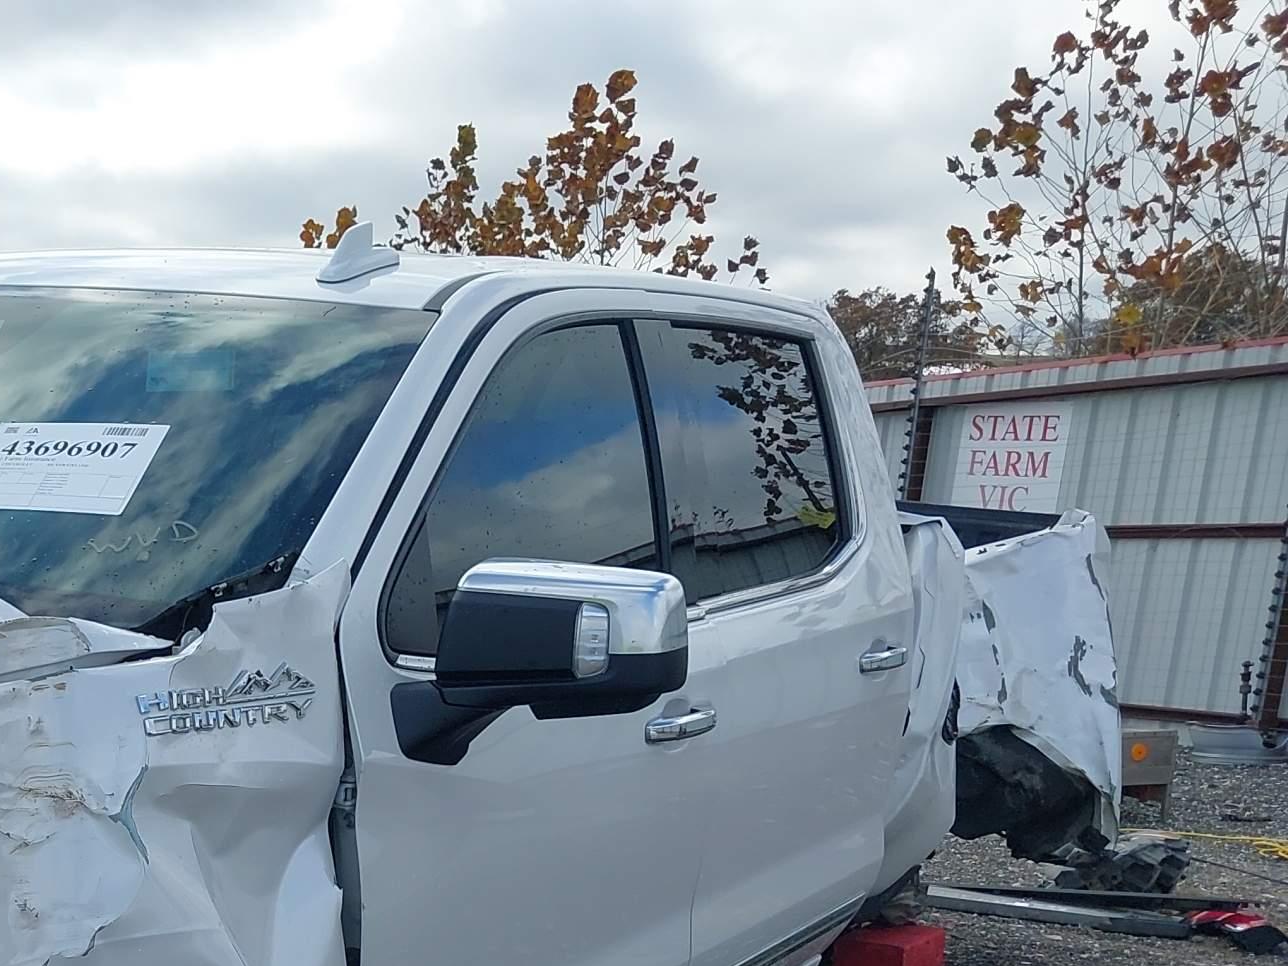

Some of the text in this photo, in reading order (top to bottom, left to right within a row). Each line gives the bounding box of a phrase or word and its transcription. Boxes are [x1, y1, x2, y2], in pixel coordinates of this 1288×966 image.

[969, 414, 1060, 441] STATE
[0, 440, 139, 459] 43696907
[967, 450, 1051, 478] FARM
[979, 485, 1029, 511] VIC
[136, 686, 227, 715] HIGH
[143, 698, 314, 737] COUNTRY
